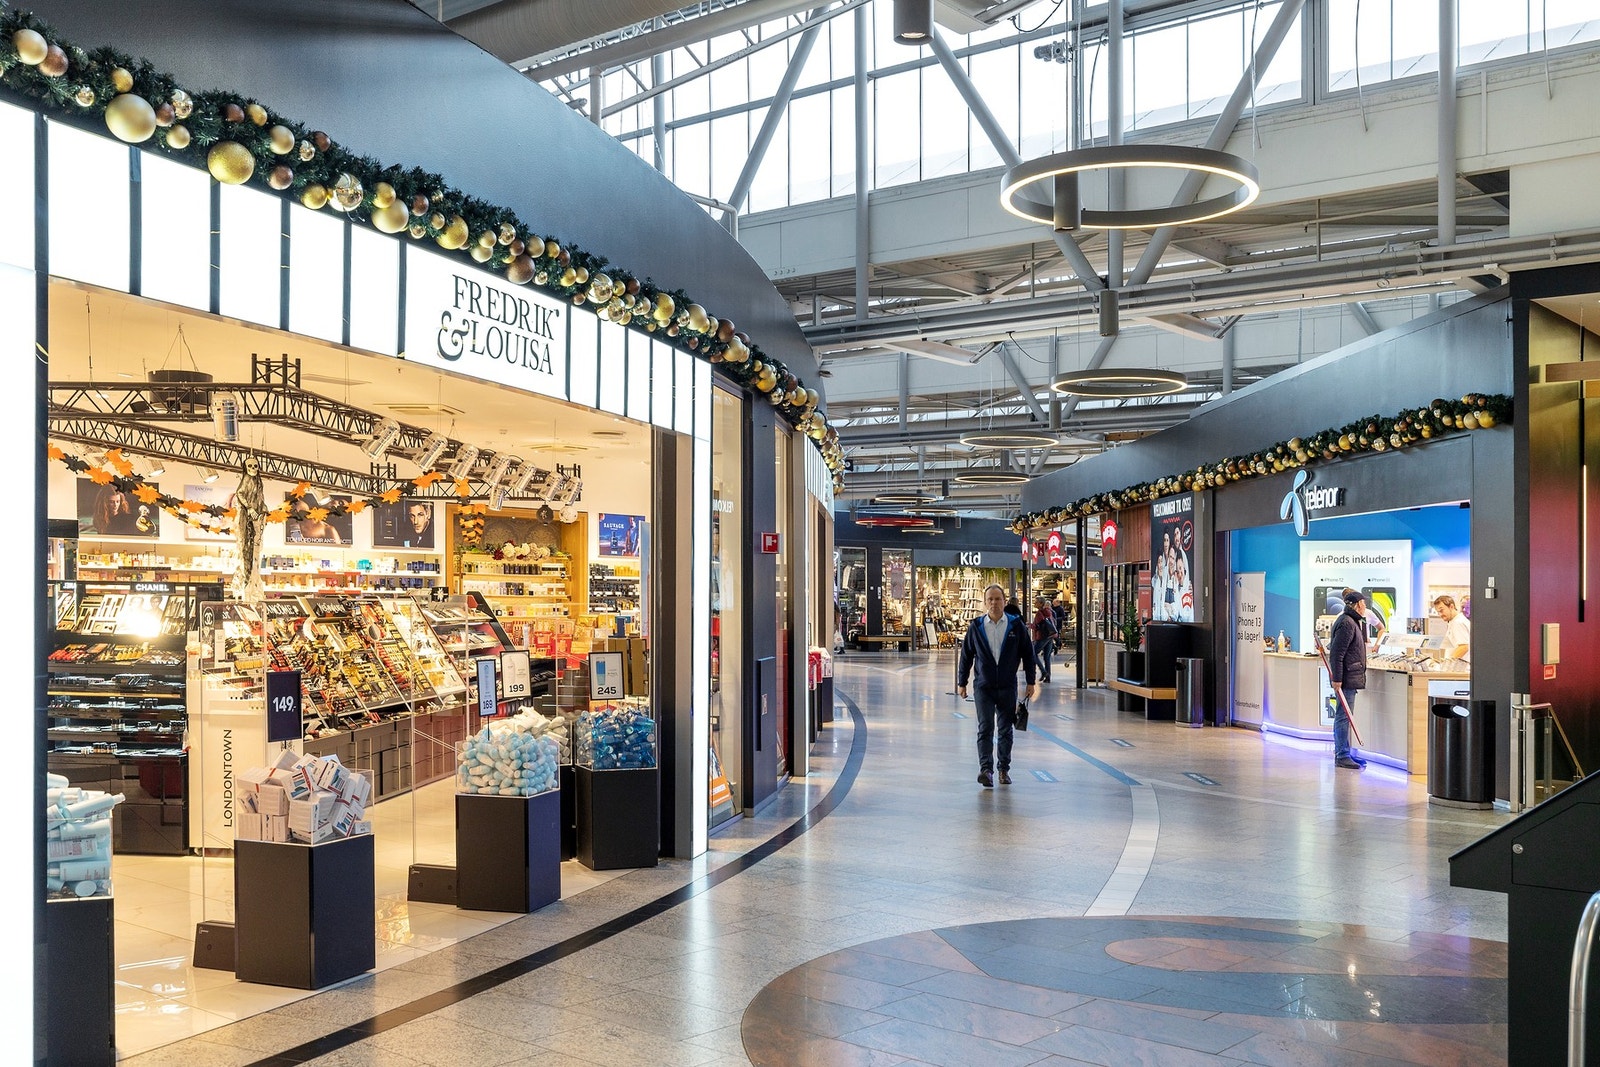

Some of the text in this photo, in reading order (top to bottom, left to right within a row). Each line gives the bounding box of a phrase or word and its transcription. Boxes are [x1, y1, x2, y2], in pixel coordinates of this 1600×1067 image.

[452, 274, 554, 340] FREDRIK
[1305, 485, 1338, 510] telenor
[1153, 500, 1175, 517] VELKOMMEN
[960, 552, 981, 566] Kid
[1315, 555, 1394, 564] AirPods inkludert
[135, 583, 169, 592] CHANEL
[1241, 603, 1256, 612] Vi har
[1255, 617, 1261, 627] 13
[1244, 631, 1260, 643] lager!
[509, 684, 524, 692] 199
[597, 687, 617, 695] 245
[482, 700, 493, 709] 169
[223, 729, 233, 828] LONDONTOWN
